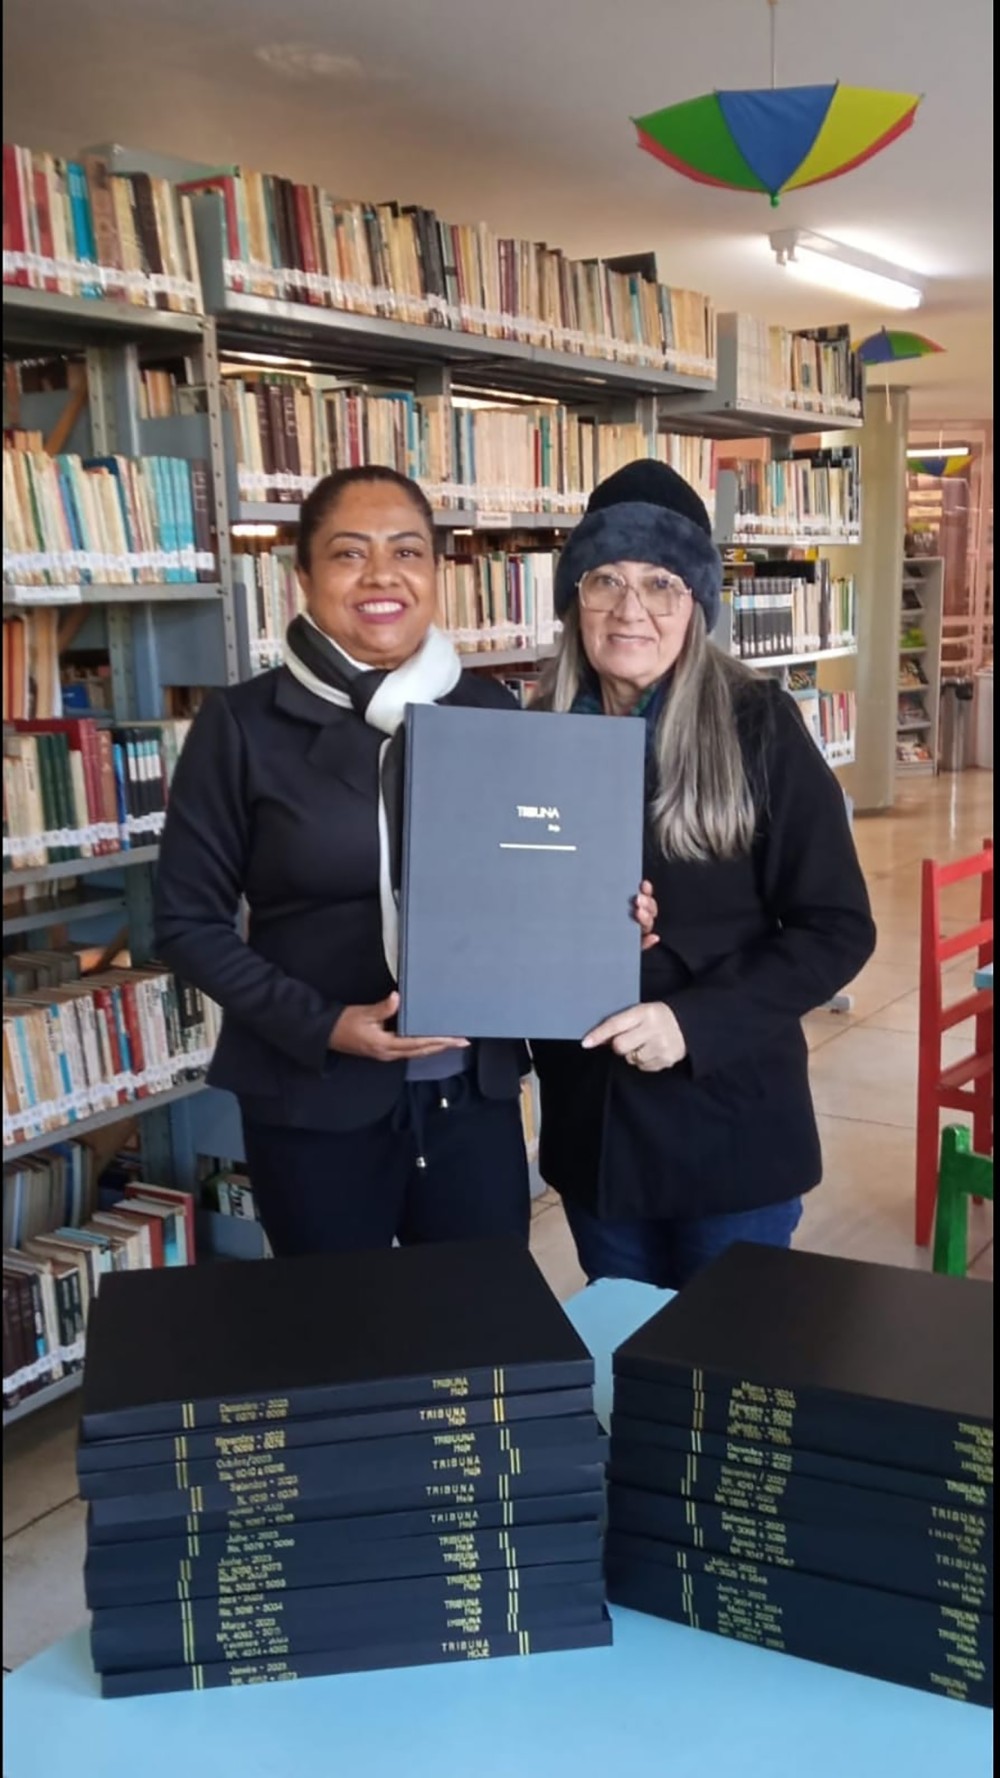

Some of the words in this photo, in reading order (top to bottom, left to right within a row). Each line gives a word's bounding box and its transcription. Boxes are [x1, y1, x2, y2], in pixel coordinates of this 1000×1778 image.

[432, 1377, 469, 1389] TRIBUNA
[420, 1407, 466, 1420] TRIBUNA
[432, 1455, 480, 1470] TRIBUNA
[425, 1484, 475, 1496] TRIBUNA
[945, 1479, 987, 1498] TRIBUNA
[430, 1509, 478, 1523] TRIBUNA
[931, 1506, 986, 1528] TRIBUNA
[438, 1533, 475, 1546] TRIBUNA
[443, 1551, 479, 1562] TRIBUNA
[935, 1553, 987, 1574] TRIBUNA
[446, 1573, 482, 1586] TRIBUNA
[444, 1598, 479, 1609] TRIBUNA
[940, 1605, 980, 1624] TRIBUNA
[937, 1627, 978, 1647] TRIBUNA
[442, 1639, 489, 1652] TRIBUNA
[946, 1653, 986, 1673] TRIBUNA
[930, 1672, 969, 1692] TRIBUNA
